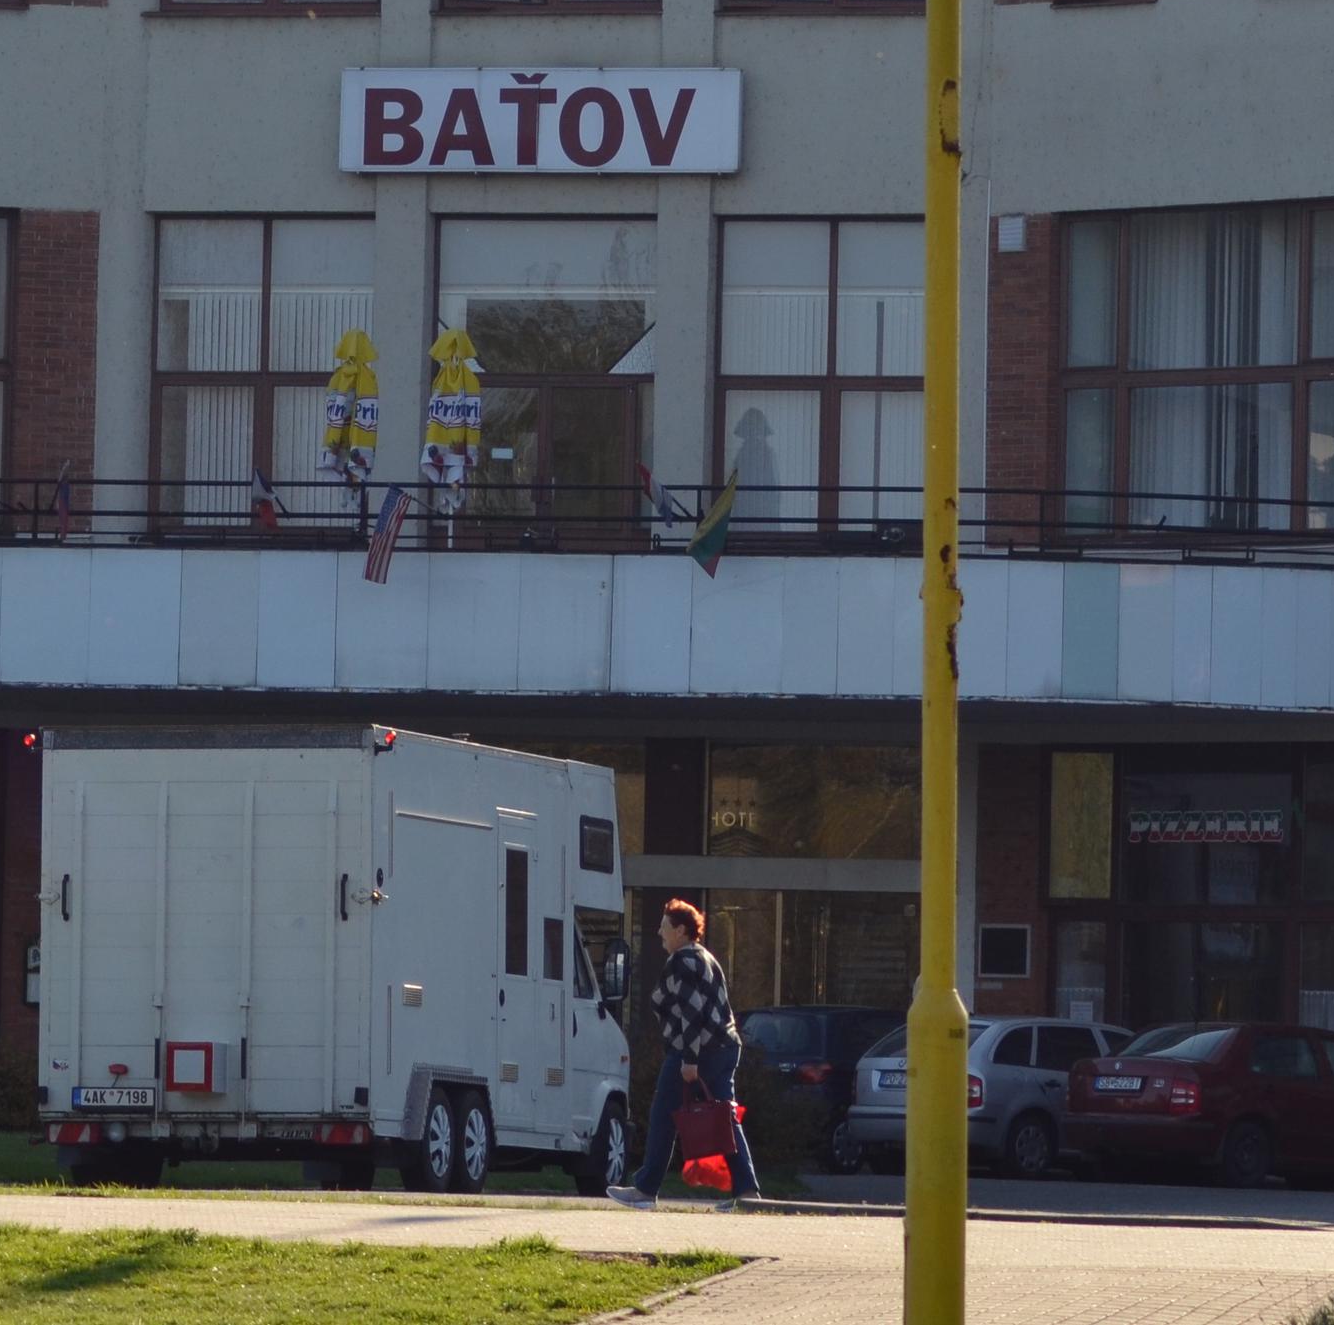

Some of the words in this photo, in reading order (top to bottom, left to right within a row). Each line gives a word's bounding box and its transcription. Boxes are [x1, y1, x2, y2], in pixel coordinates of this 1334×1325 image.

[363, 72, 697, 168] BAŤOV
[1128, 810, 1283, 843] PIZZERIE
[83, 1090, 107, 1105] 4AK
[116, 1090, 148, 1105] 7198
